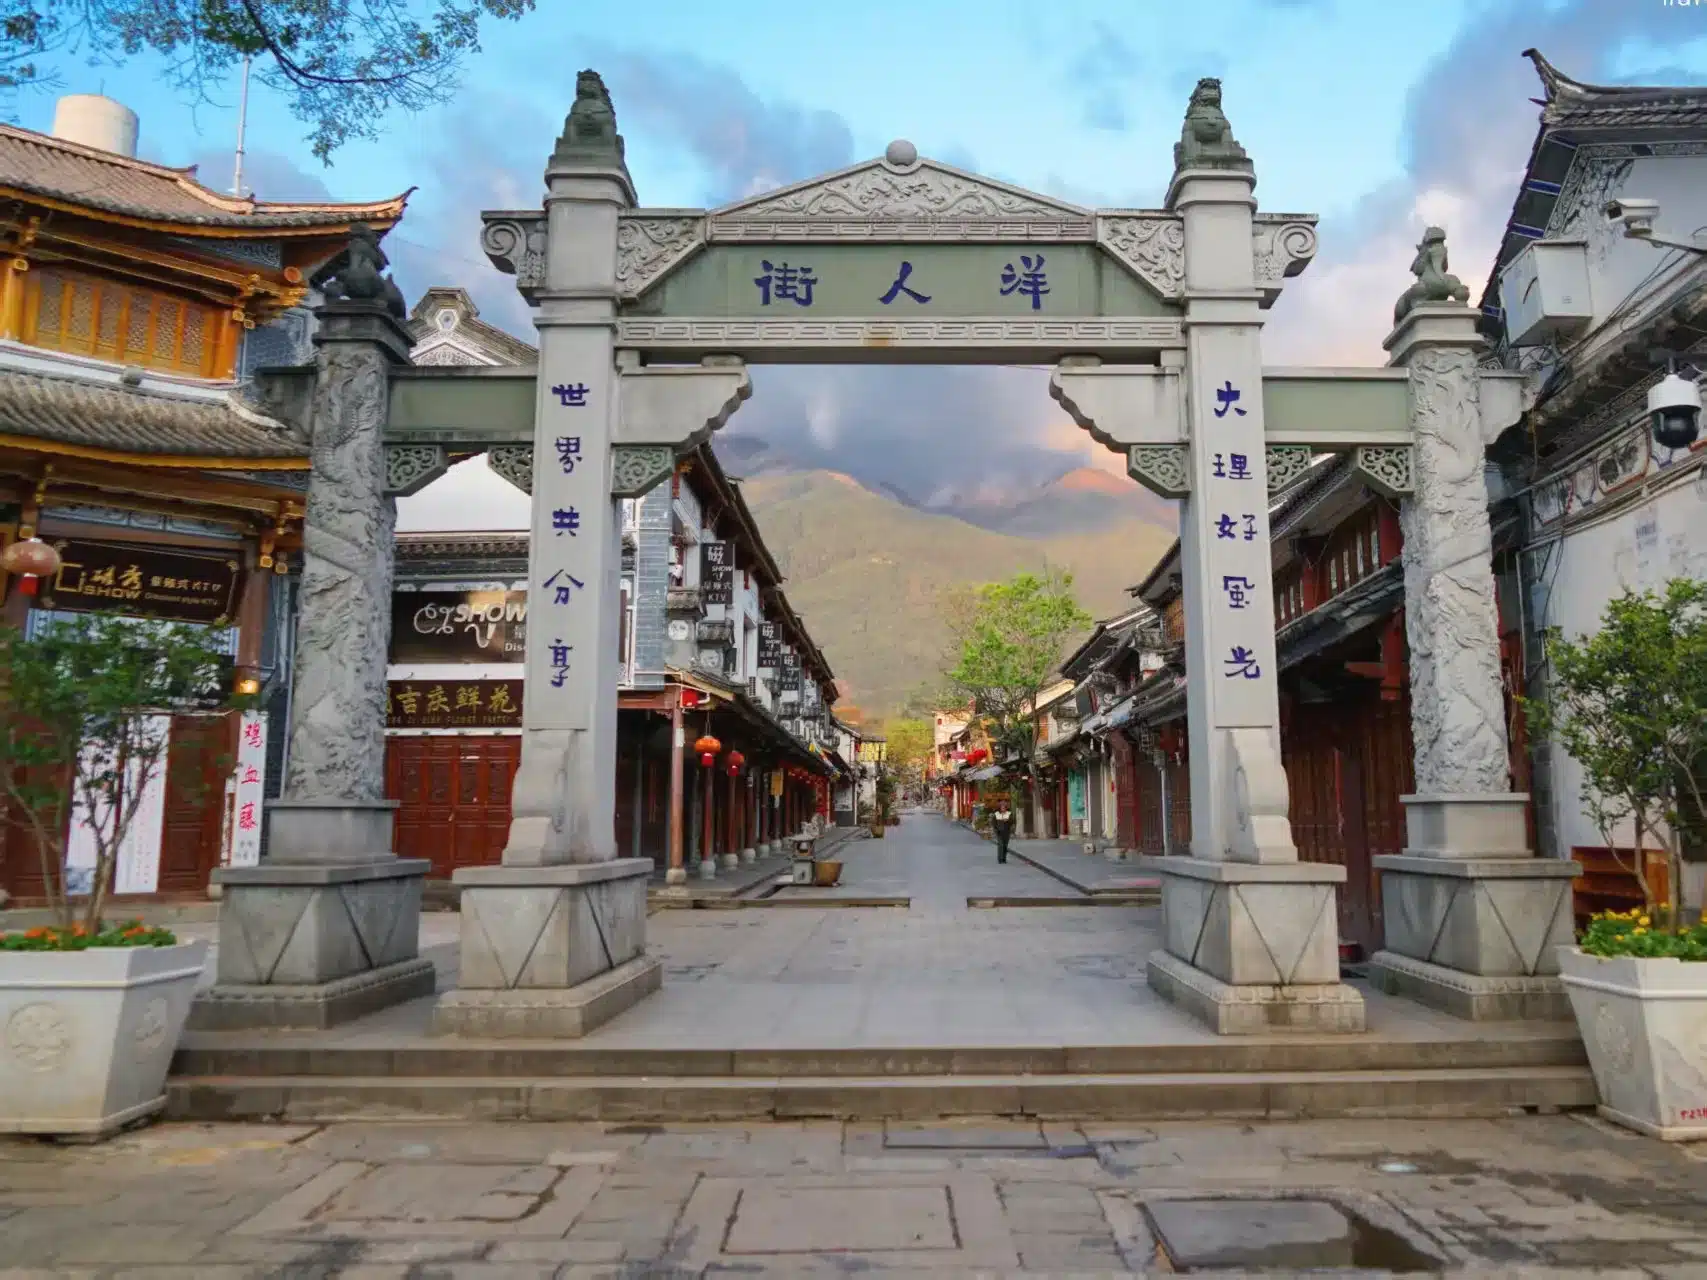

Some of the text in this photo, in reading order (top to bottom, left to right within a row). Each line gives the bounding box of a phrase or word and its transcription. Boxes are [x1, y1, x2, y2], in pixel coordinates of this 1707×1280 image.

[543, 382, 590, 688] 世界共分享
[82, 585, 141, 600] SHOW
[708, 593, 726, 601] KTV
[454, 603, 528, 622] SHOW
[387, 684, 518, 714] 吉庆鲜花
